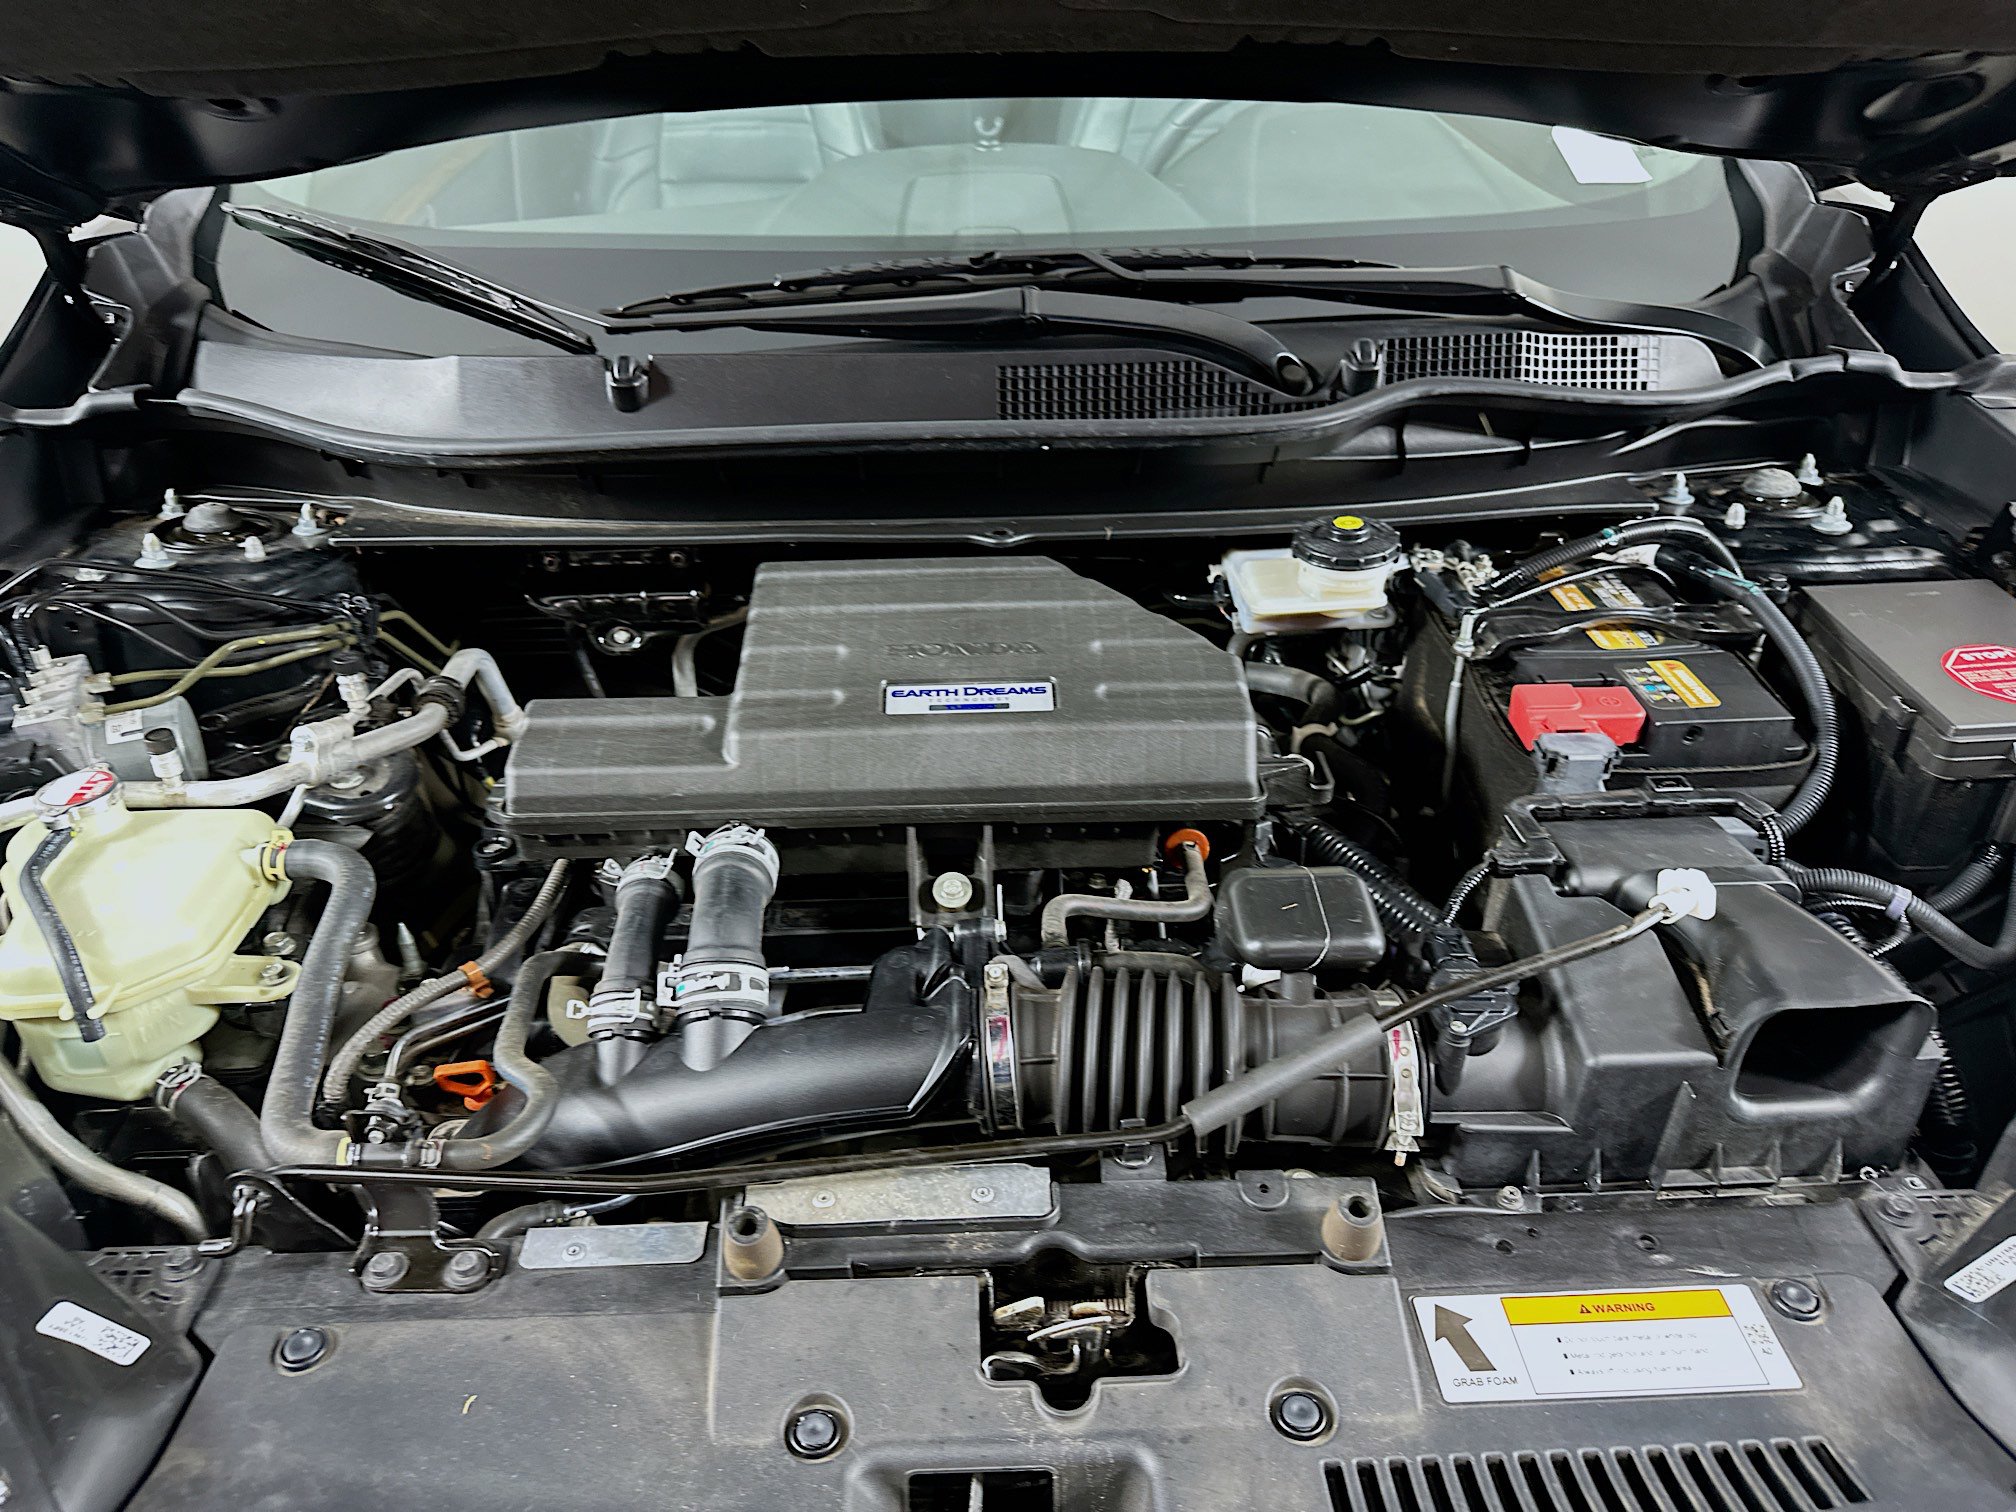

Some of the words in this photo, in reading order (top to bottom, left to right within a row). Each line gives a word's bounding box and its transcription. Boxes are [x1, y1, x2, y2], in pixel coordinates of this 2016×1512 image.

[892, 688, 958, 697] EARTH
[1592, 1303, 1655, 1312] WARNING
[1453, 1377, 1484, 1387] GRAB
[1486, 1376, 1518, 1386] FOAM
